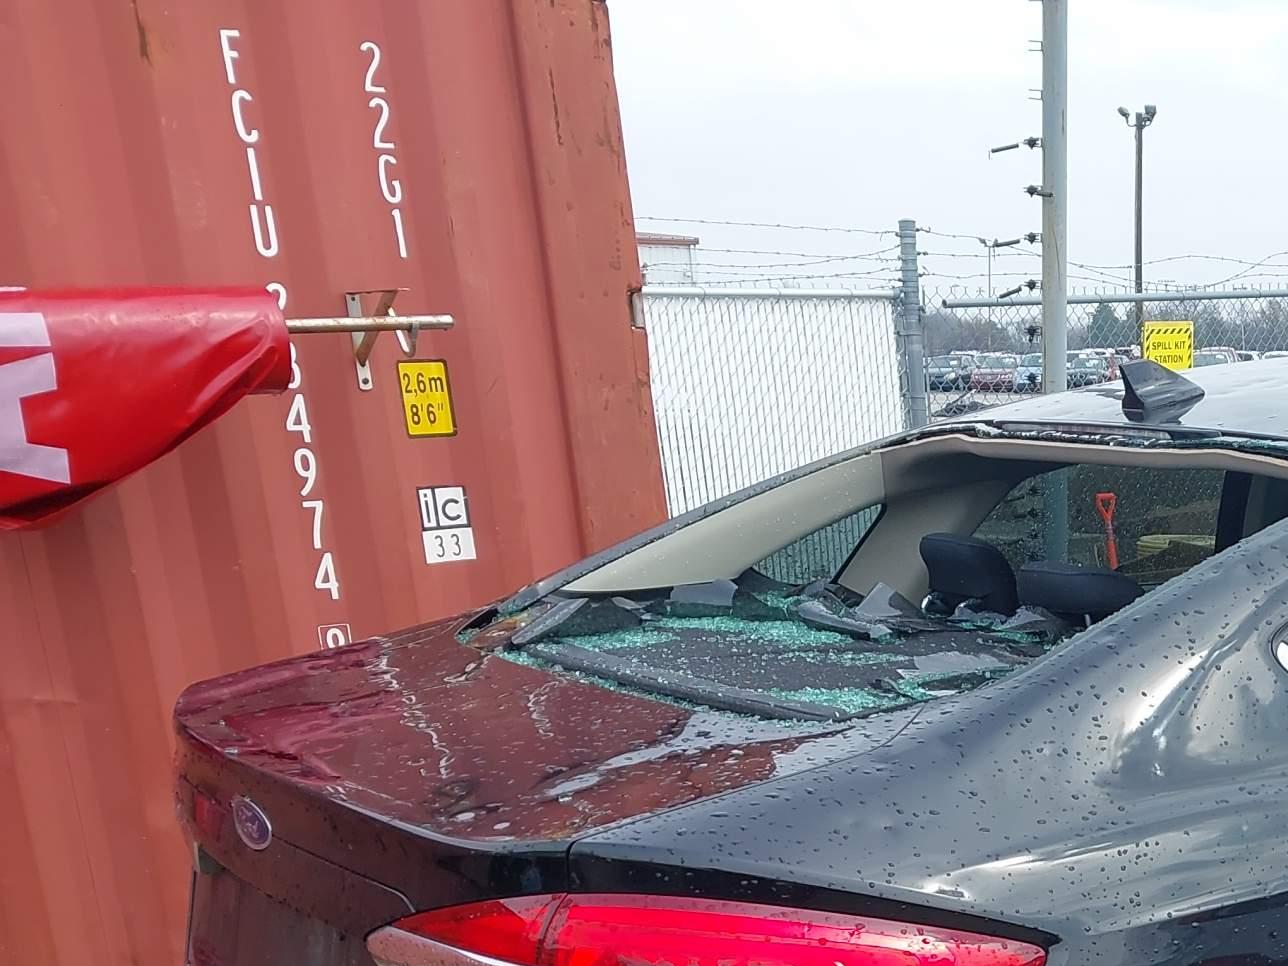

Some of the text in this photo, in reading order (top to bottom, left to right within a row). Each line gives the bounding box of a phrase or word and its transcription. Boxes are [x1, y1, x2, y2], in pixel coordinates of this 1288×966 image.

[220, 29, 279, 257] FCIU
[360, 41, 408, 258] 22G1
[1152, 340, 1186, 350] SPILL KIT
[1154, 354, 1184, 364] STATION
[434, 533, 462, 558] 33
